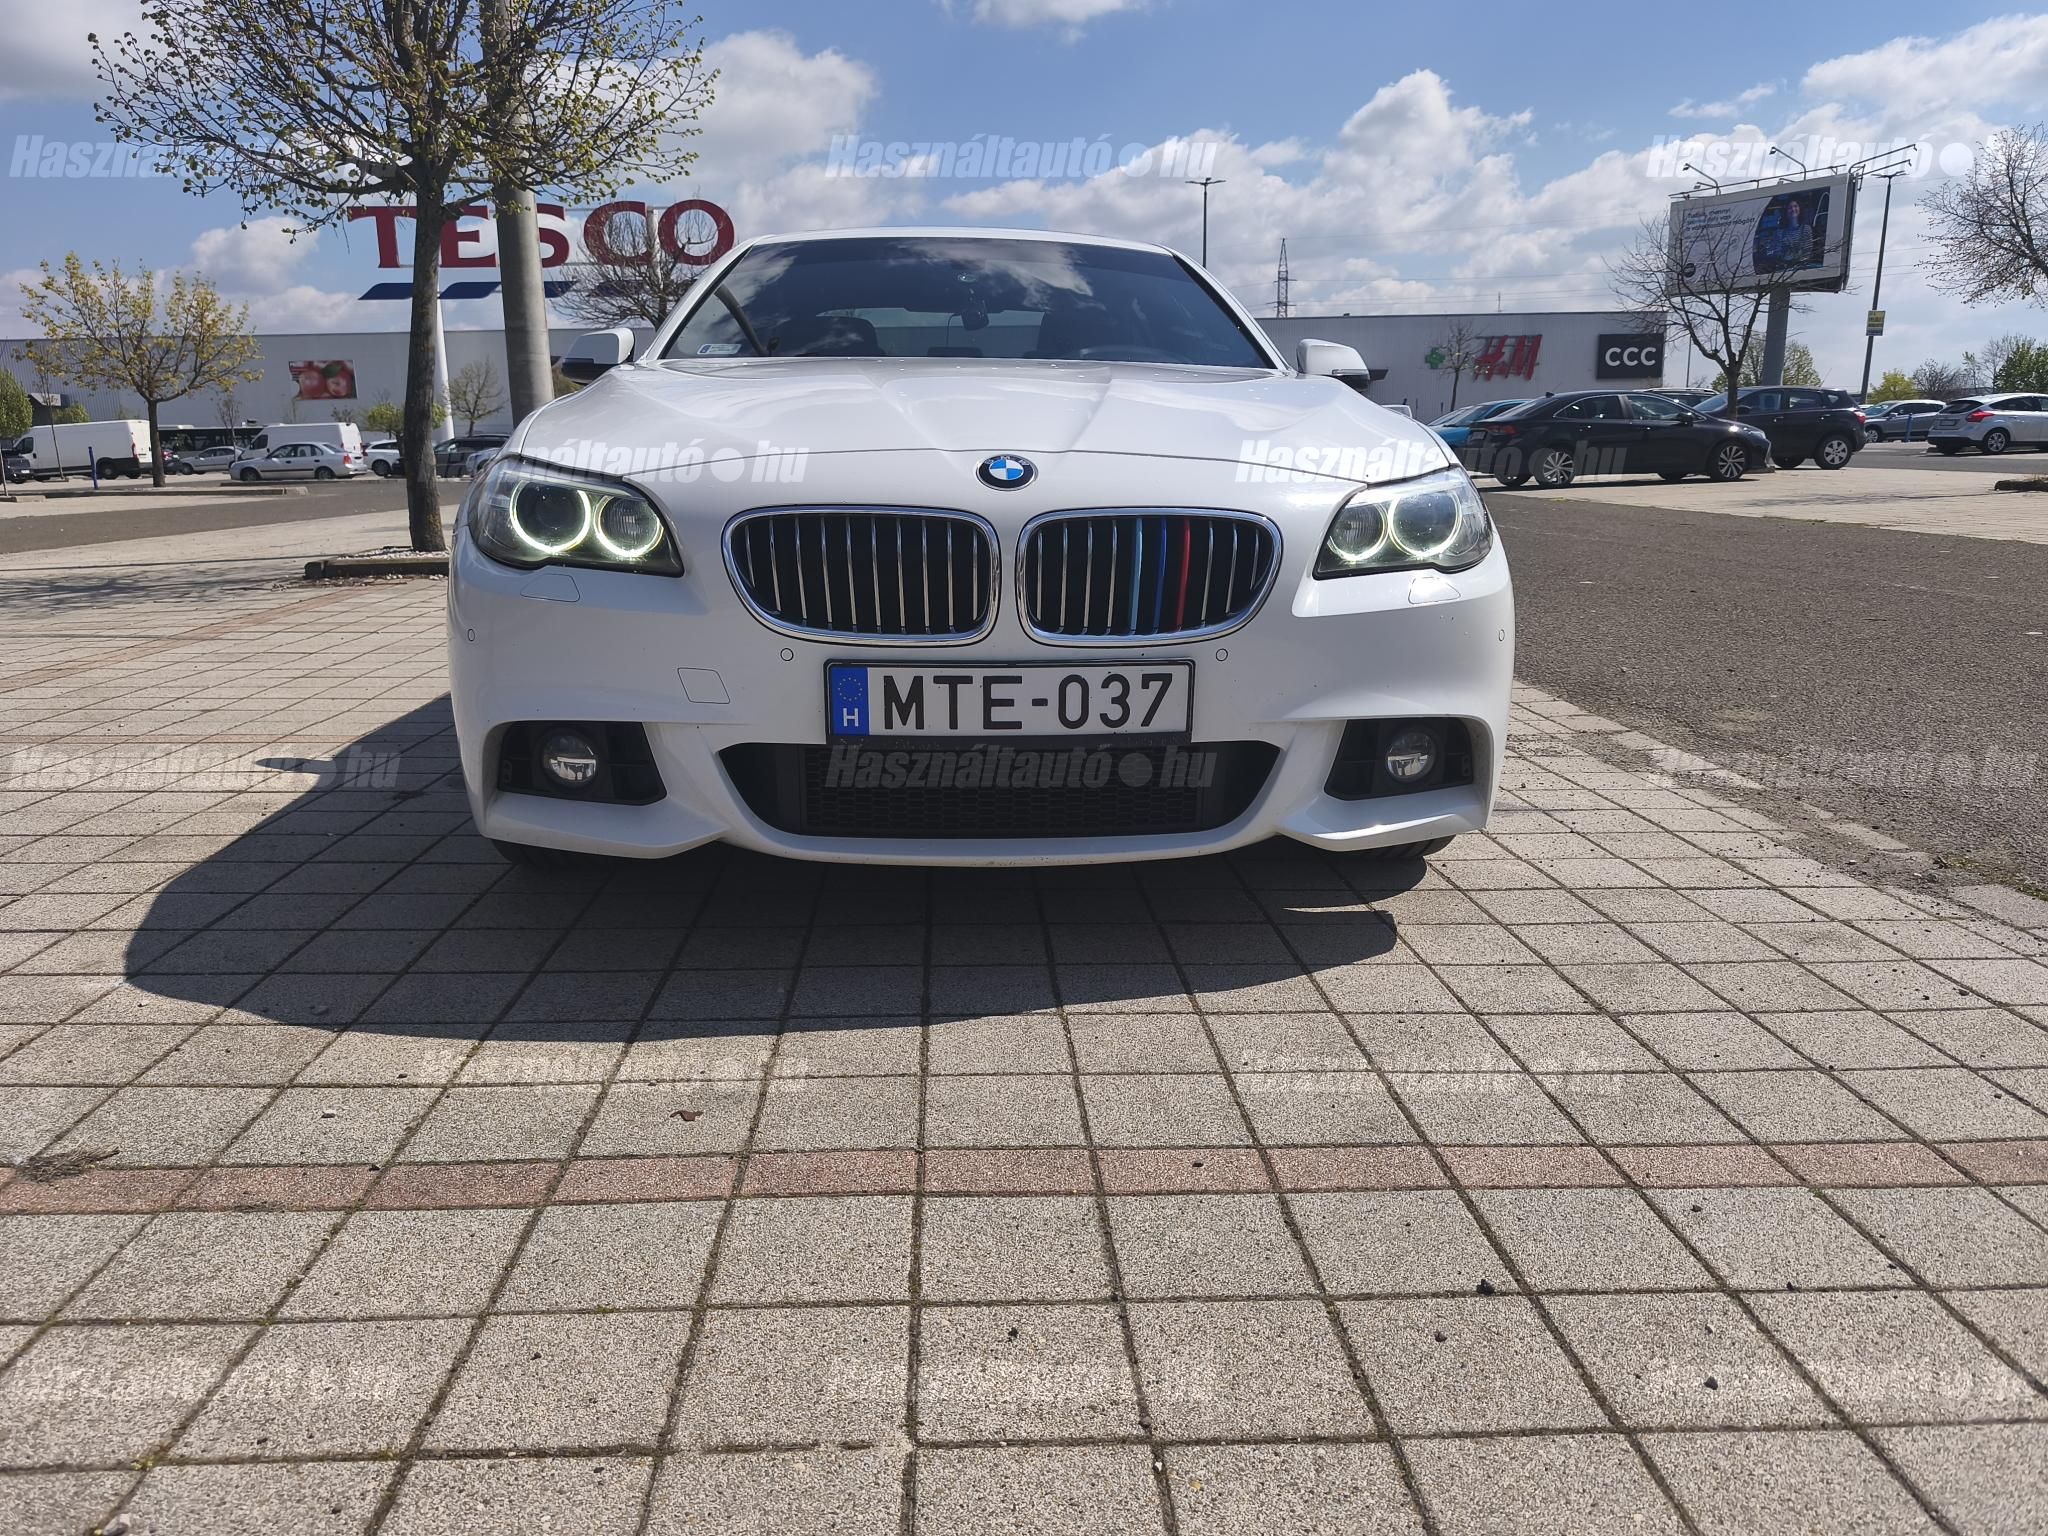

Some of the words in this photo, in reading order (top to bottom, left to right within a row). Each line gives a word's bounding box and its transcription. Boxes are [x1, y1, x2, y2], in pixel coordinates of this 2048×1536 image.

[1605, 347, 1656, 366] CCC
[882, 673, 1173, 731] MTE-037
[842, 707, 860, 727] H
